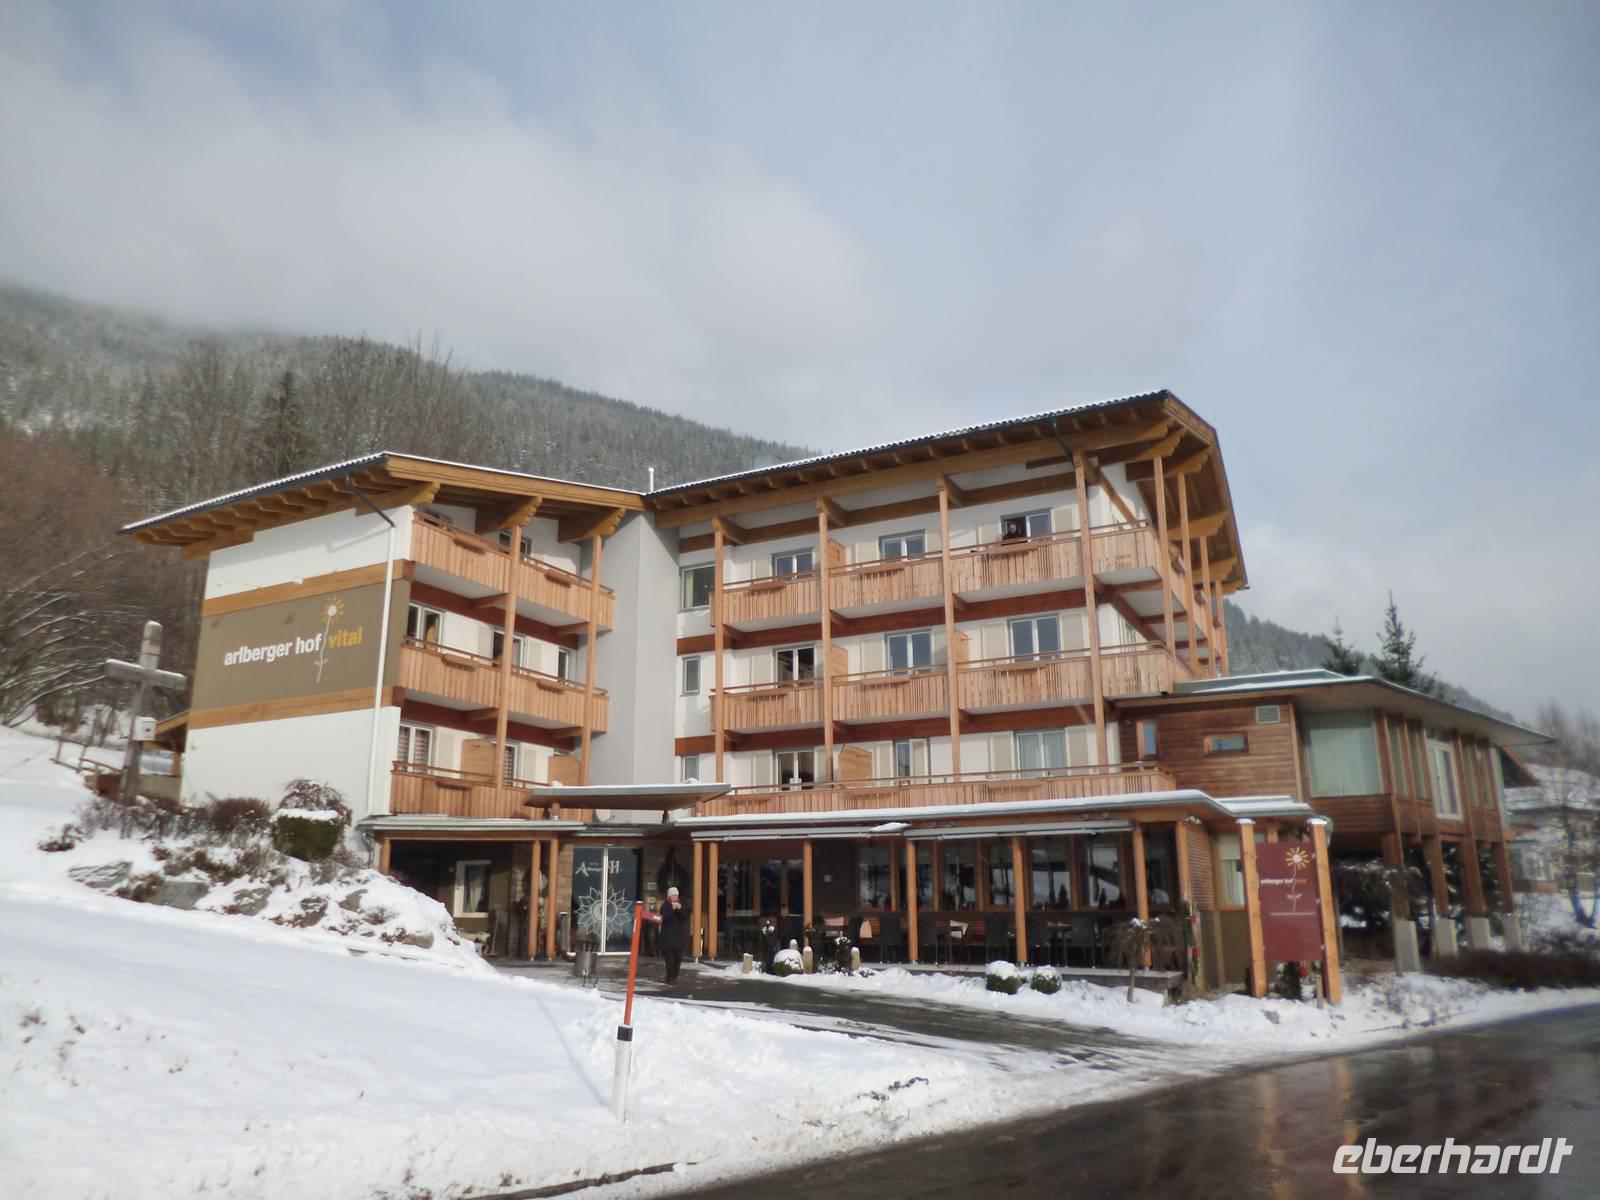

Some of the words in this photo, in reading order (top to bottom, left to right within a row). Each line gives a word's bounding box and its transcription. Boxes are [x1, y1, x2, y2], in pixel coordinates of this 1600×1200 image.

[224, 643, 292, 666] arlberger
[296, 633, 322, 654] hof
[328, 627, 363, 648] vital
